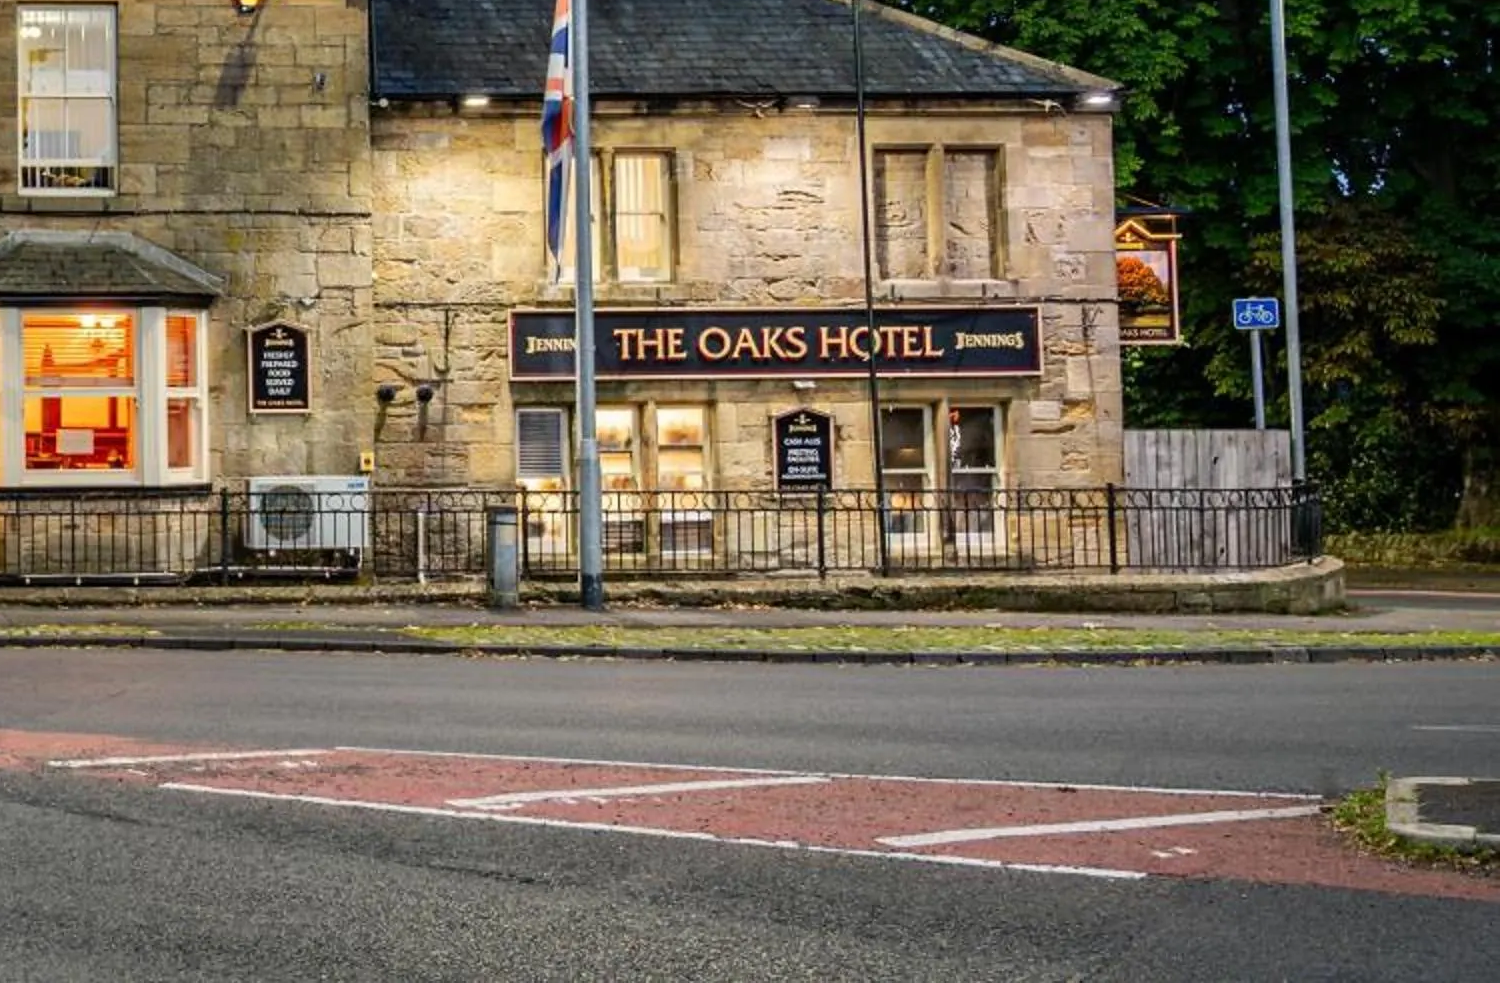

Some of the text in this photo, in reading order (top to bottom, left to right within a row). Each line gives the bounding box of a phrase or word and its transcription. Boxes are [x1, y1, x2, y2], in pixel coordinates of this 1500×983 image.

[525, 336, 577, 354] JENNIN
[613, 326, 945, 361] THE OAKS HOTEL
[954, 331, 1025, 350] JENNINGS
